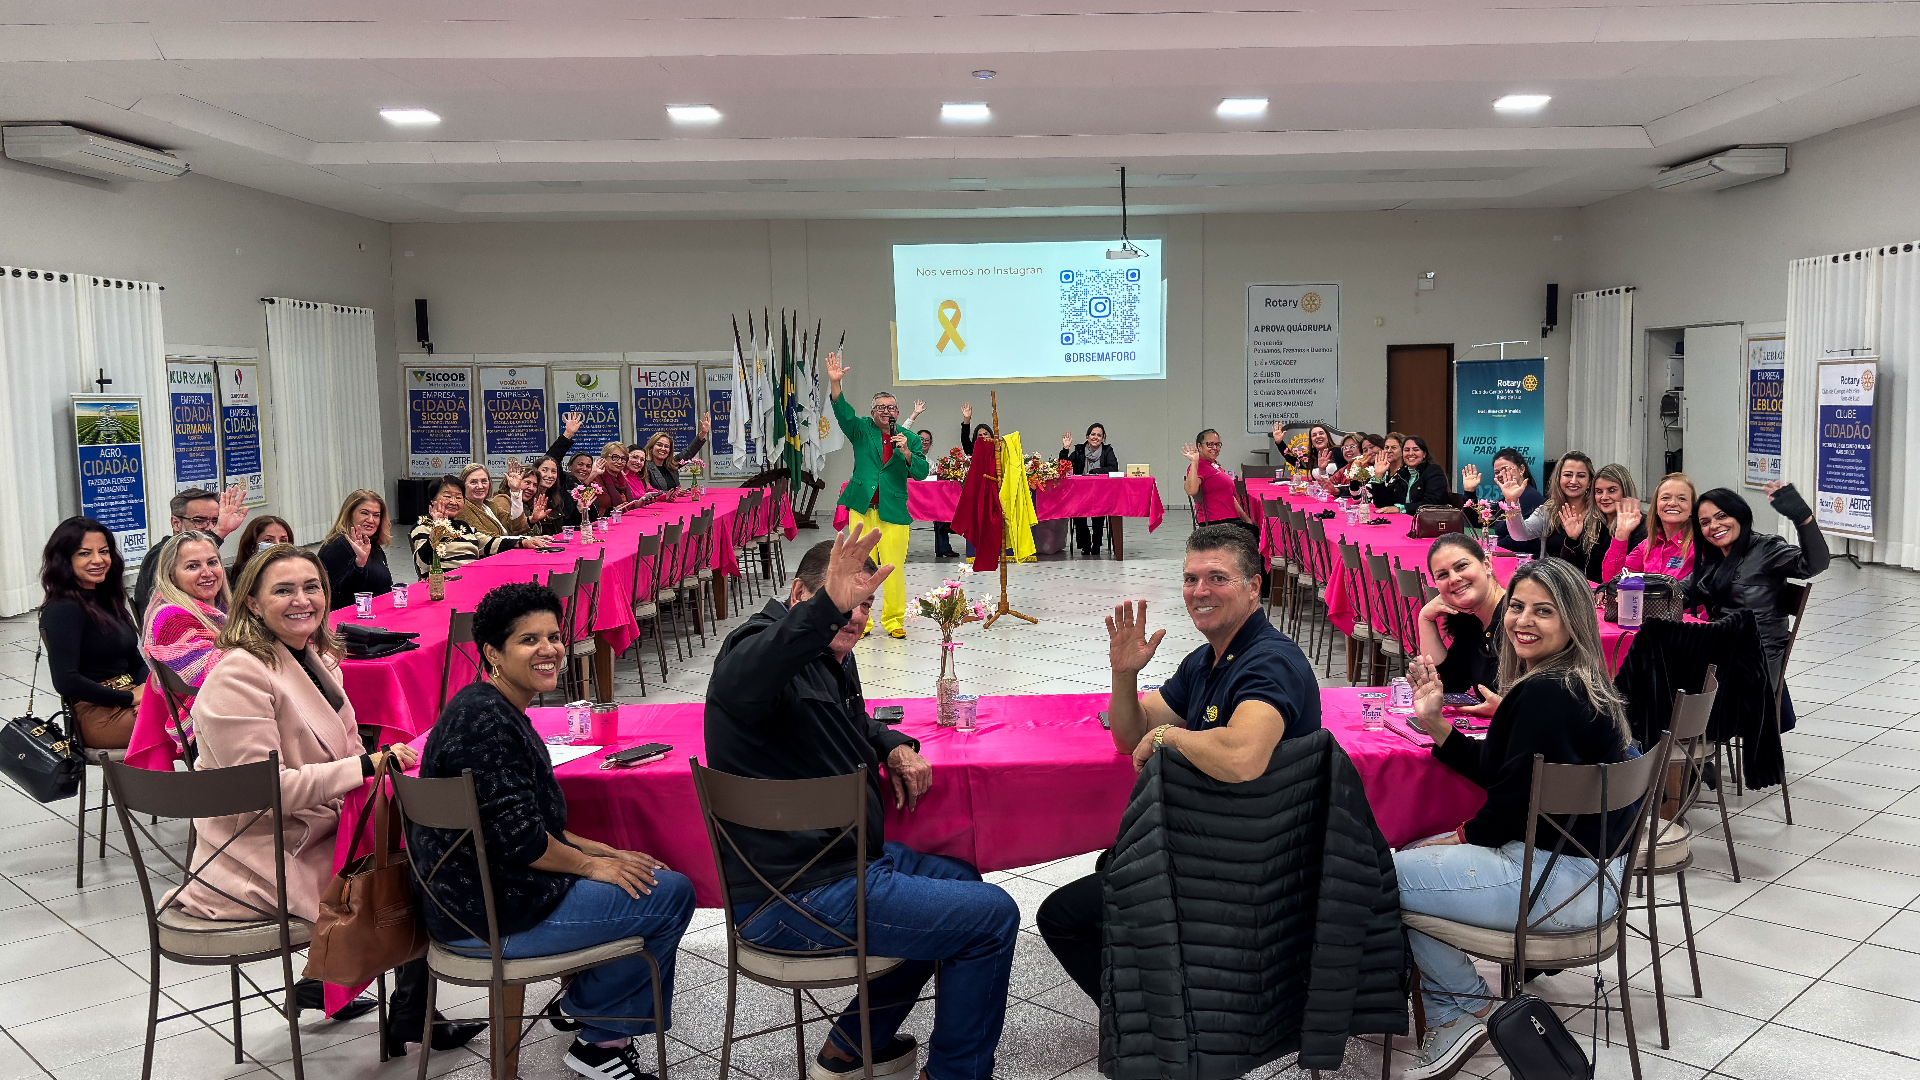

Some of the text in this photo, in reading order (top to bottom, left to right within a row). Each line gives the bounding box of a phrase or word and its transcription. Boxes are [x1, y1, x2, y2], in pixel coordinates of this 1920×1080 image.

[916, 266, 1043, 277] Nos vemos no Instagran
[1264, 297, 1299, 309] Rotary
[1253, 322, 1332, 333] A PROVA QUÁDRUPLA
[1064, 351, 1136, 363] @DRSEMAFORO
[425, 372, 466, 382] SICOOB
[637, 367, 690, 387] HECON
[1757, 371, 1780, 381] EMPRESA
[1840, 375, 1860, 387] Rotary
[1497, 379, 1521, 389] Rotary
[422, 391, 456, 399] EMPRESA
[496, 390, 531, 399] EMPRESA
[566, 391, 586, 399] Santa
[647, 389, 682, 397] EMPRESA
[180, 395, 205, 405] EMPRESA
[412, 396, 467, 412] CIDADÃ
[487, 395, 542, 412] CIDADÃ
[637, 393, 693, 410] CIDADÃ
[174, 402, 213, 423] CIDADÃ
[229, 408, 250, 418] EMPRESA
[569, 404, 605, 412] EMPRESA
[421, 412, 459, 421] SICOOB
[491, 411, 539, 421] VOX2YOU
[644, 410, 687, 419] HECON
[1835, 408, 1857, 419] CLUBE
[224, 413, 257, 434] CIDADÃ
[175, 423, 213, 435] KURMANN
[1824, 420, 1871, 440] CIDADÃO
[1462, 436, 1498, 445] UNIDOS
[99, 448, 122, 458] AGRO
[1473, 445, 1497, 455] PARA
[83, 455, 139, 476] CIDADÃO
[448, 456, 471, 465] ABTRF
[111, 476, 136, 485] FLORESTA
[123, 533, 146, 547] ABTRF
